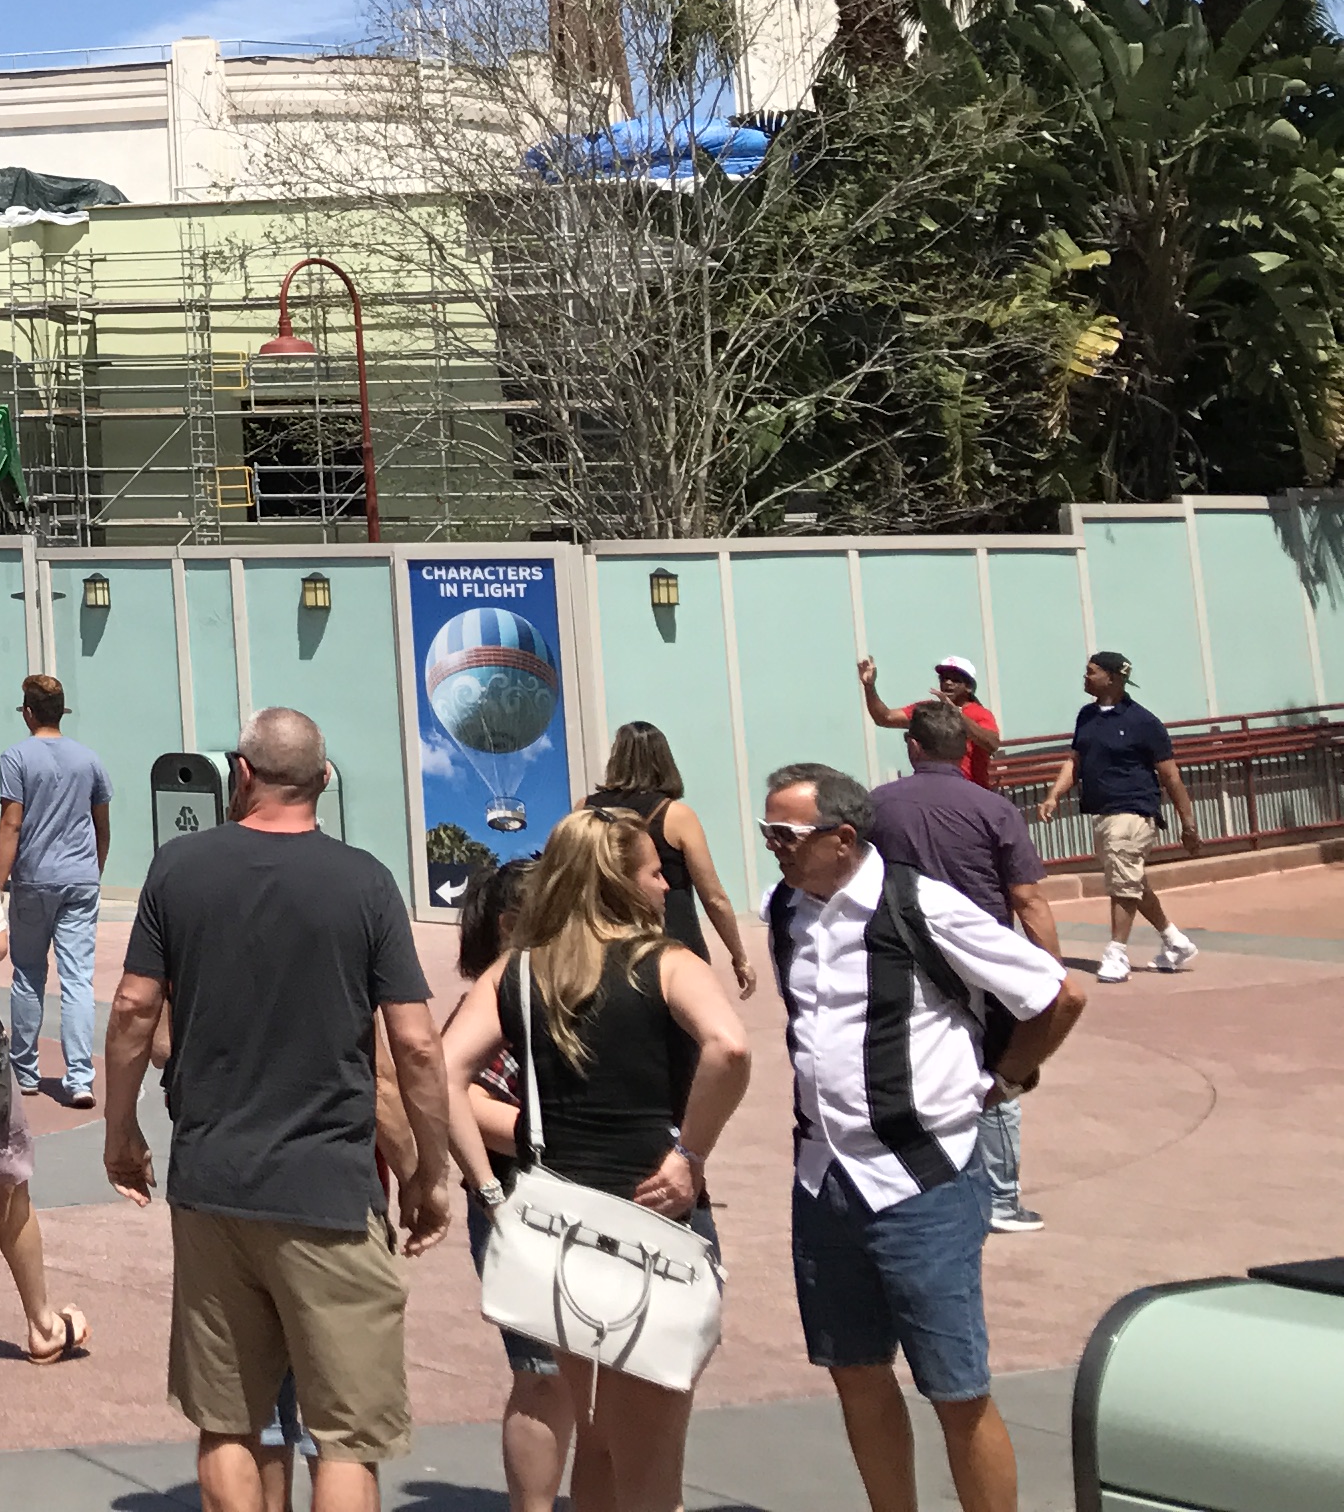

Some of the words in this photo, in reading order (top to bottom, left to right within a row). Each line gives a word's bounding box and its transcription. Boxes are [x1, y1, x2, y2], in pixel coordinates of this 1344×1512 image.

[421, 565, 544, 581] CHARACTERS
[439, 582, 459, 598] IN
[462, 582, 528, 598] FLIGHT
